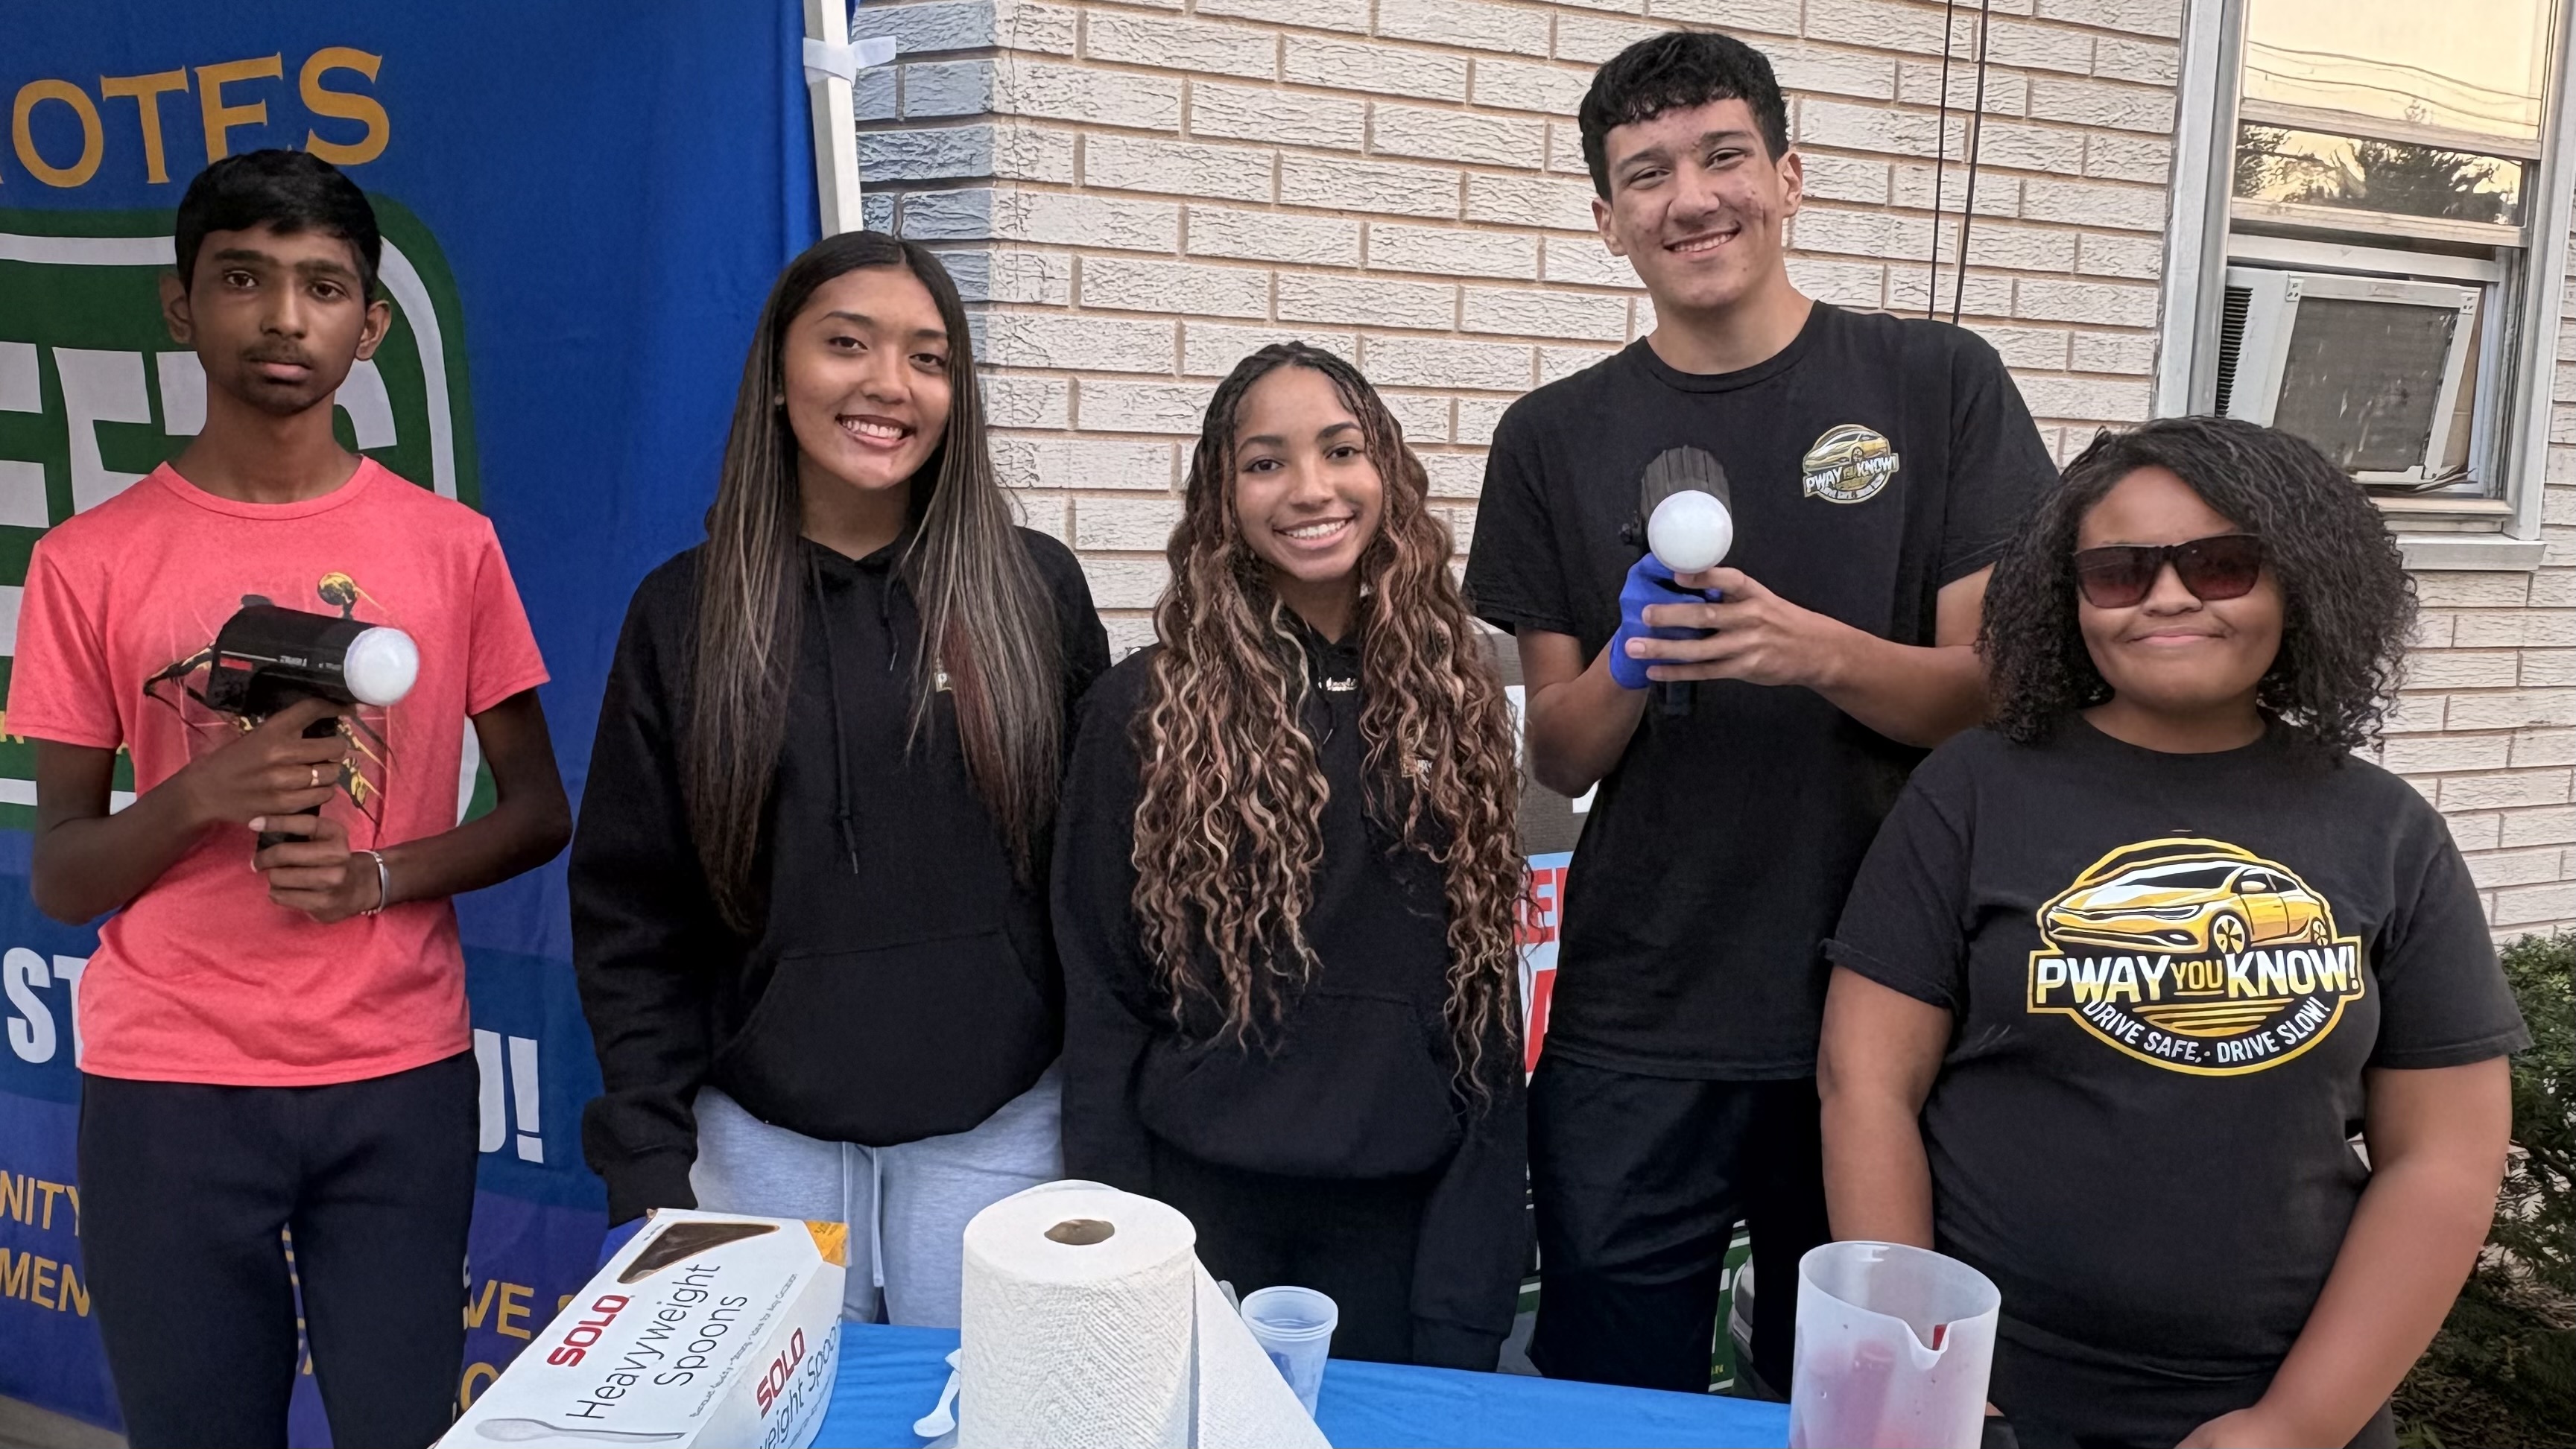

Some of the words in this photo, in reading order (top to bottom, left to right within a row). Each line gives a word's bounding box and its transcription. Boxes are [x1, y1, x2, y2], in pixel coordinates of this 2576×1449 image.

[0, 45, 390, 188] OTES
[1805, 466, 1843, 493] PWAY
[2037, 954, 2171, 1003] PWAY
[2170, 960, 2223, 990] YOU
[2224, 945, 2359, 998] KNOW!
[2082, 1000, 2146, 1044] DRIVE
[2143, 1031, 2203, 1063] SAFE,
[2216, 1030, 2281, 1063] DRIVE
[2276, 996, 2332, 1045] SLOW!
[546, 1295, 630, 1367] SOLO
[566, 1263, 721, 1419] Heavyweight
[654, 1296, 748, 1386] Spoons
[756, 1327, 806, 1421] SOLO
